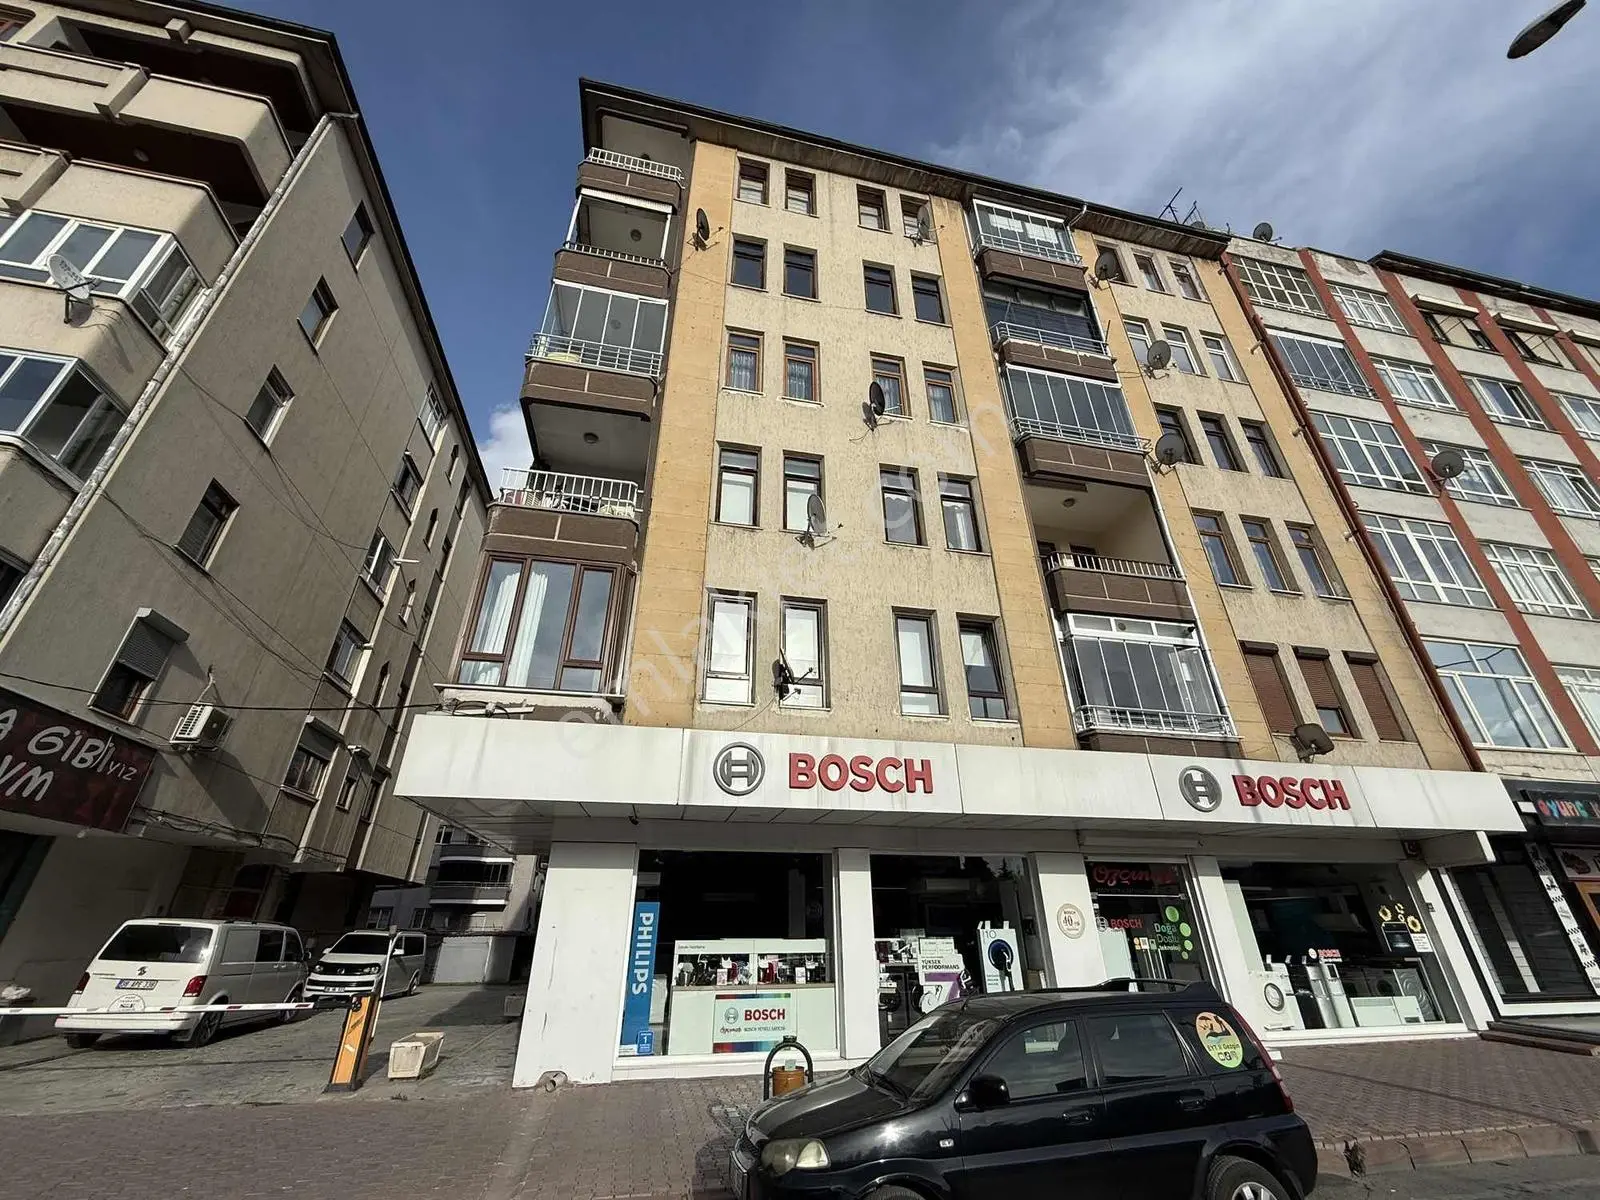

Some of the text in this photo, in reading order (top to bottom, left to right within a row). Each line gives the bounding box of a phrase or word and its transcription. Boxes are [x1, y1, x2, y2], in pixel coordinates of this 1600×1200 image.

[788, 752, 934, 794] BOSCH
[1231, 774, 1351, 810] BOSCH
[1111, 918, 1143, 929] BOSCH
[632, 913, 654, 994] PHILIPS
[744, 1008, 786, 1021] BOSCH
